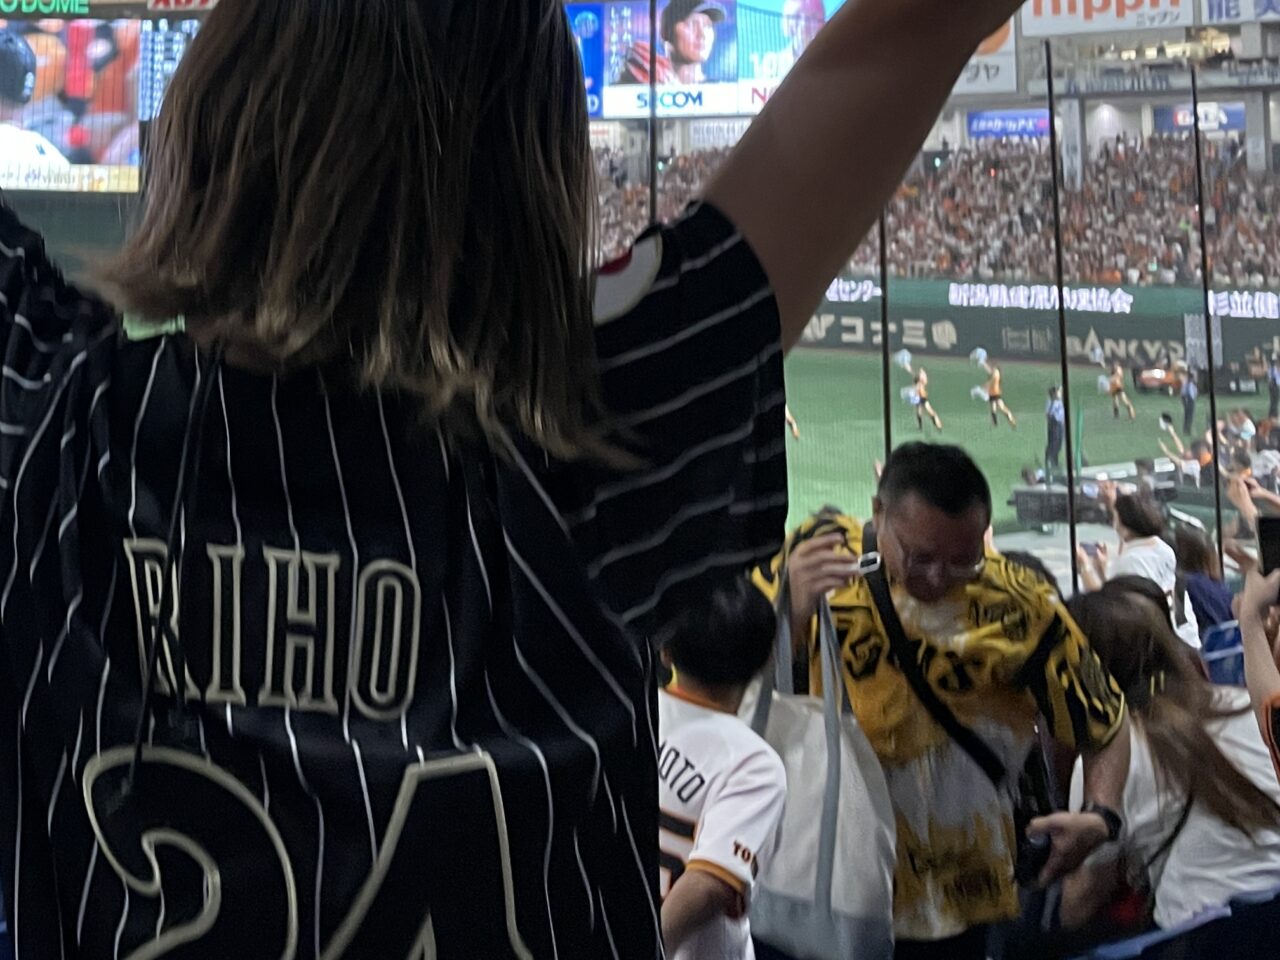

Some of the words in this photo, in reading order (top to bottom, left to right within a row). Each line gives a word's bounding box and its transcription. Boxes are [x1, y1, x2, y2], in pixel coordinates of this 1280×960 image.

[637, 90, 703, 108] SCOM
[123, 538, 421, 721] RIHO
[659, 741, 706, 804] OTO
